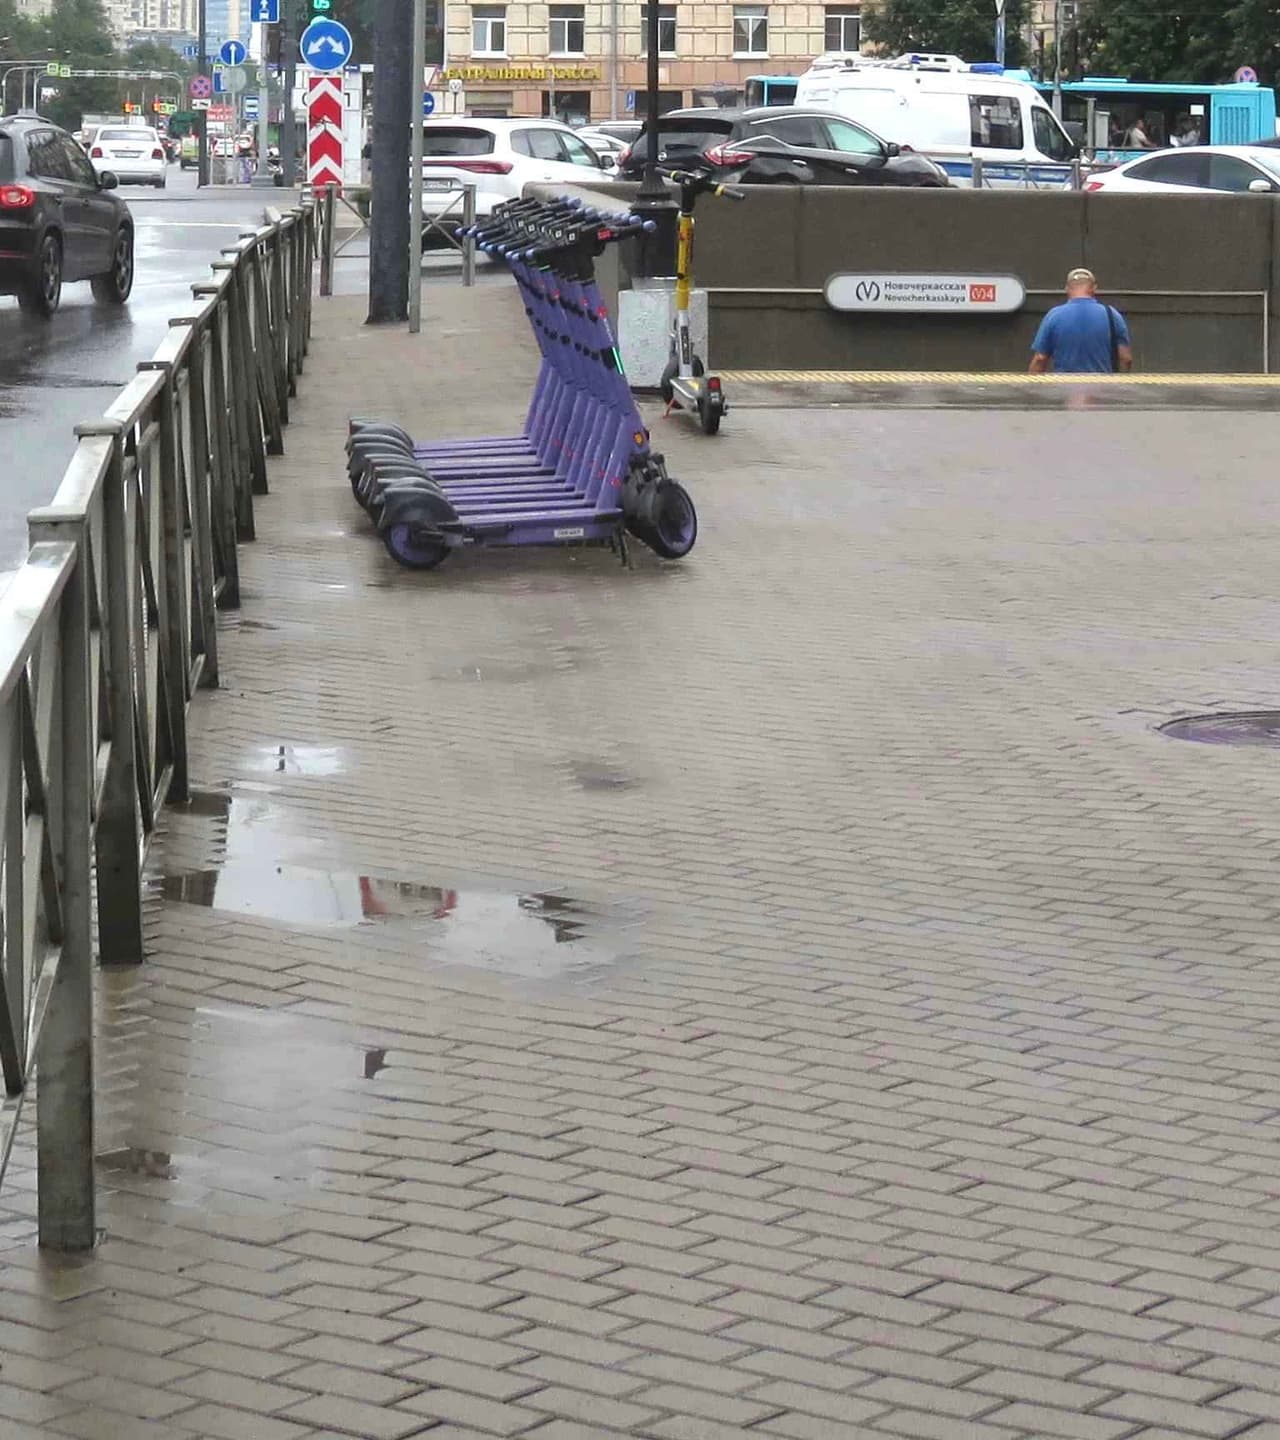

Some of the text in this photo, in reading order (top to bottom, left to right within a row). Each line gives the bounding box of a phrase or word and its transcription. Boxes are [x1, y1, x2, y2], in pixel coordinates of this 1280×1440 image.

[440, 65, 602, 80] ЕАТРАЛЬНАЯ КАССА
[884, 281, 967, 292] Новочеркасская
[884, 294, 966, 304] Novocherkasskaya
